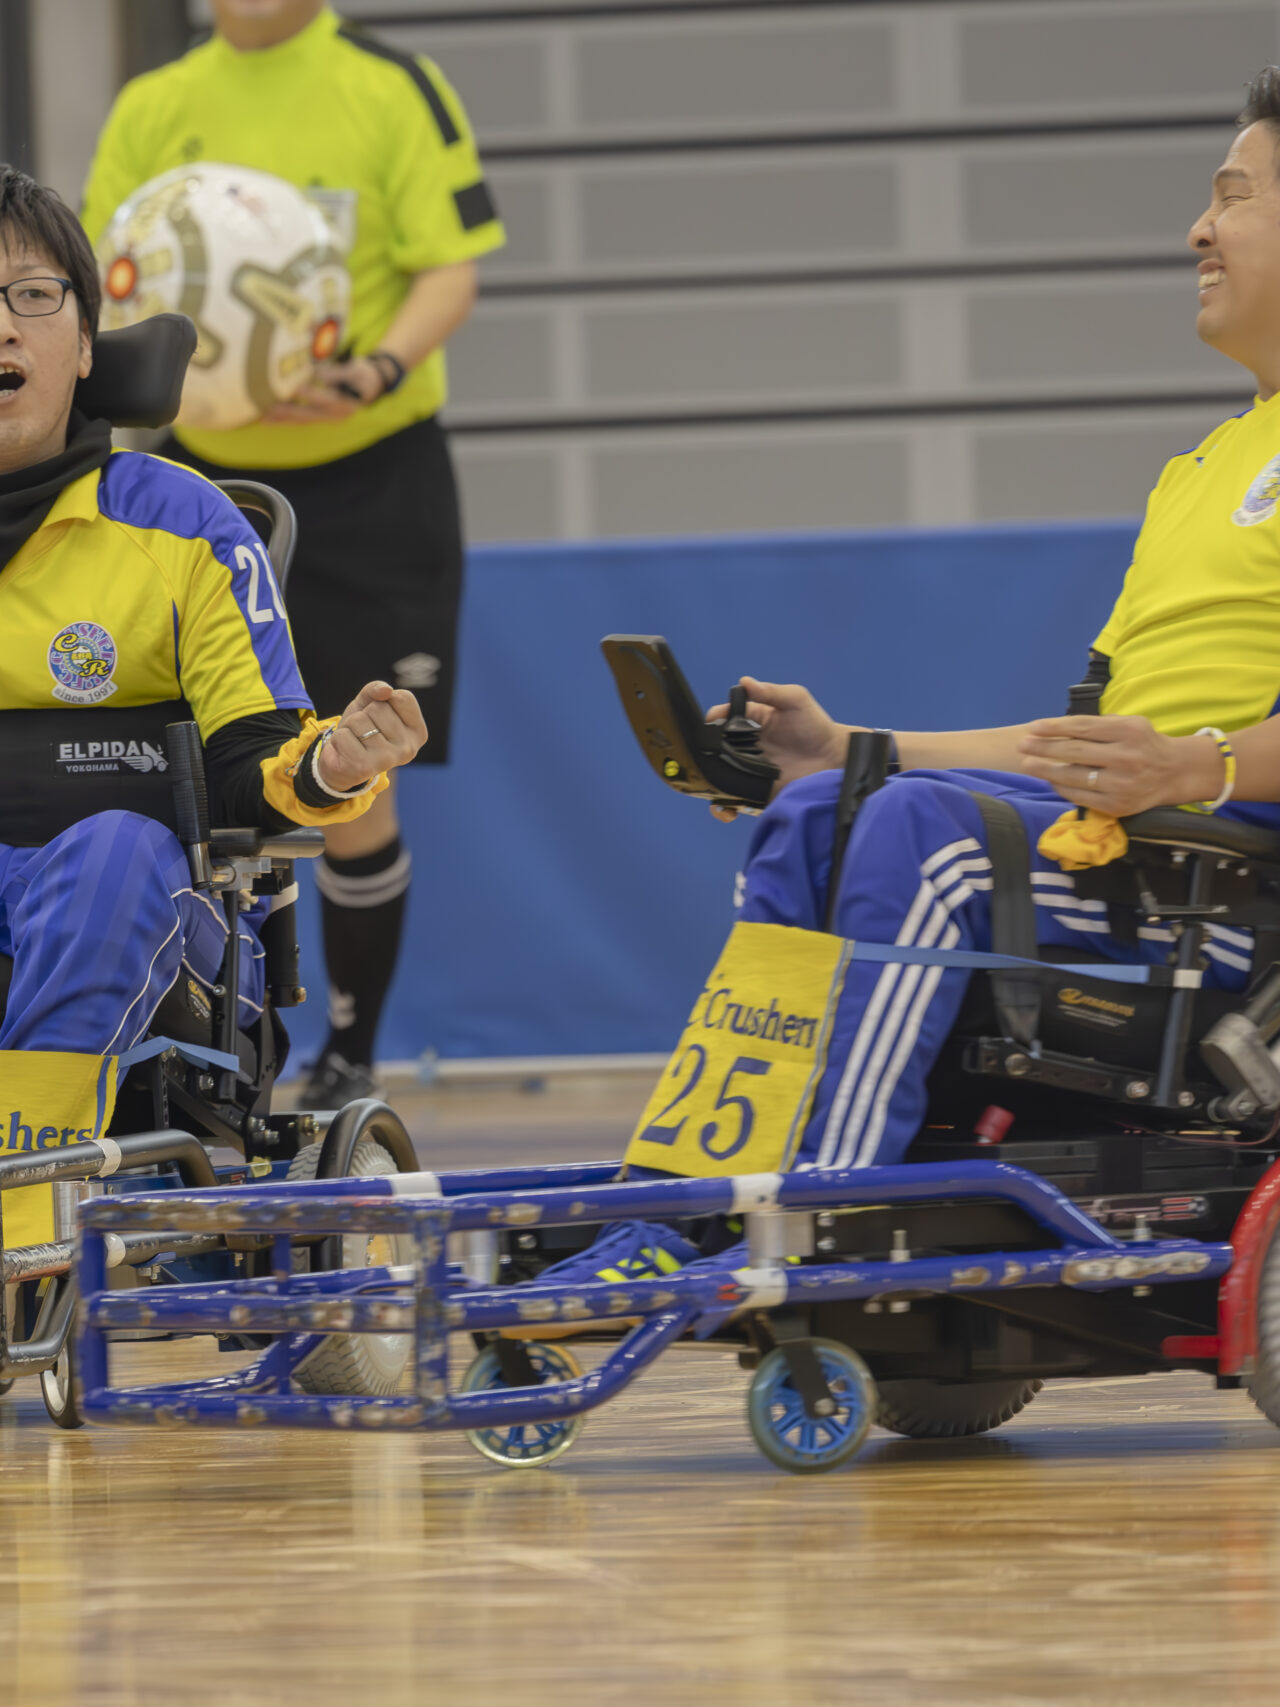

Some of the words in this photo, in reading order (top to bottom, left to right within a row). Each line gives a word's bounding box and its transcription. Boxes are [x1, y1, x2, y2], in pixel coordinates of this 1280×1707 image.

[53, 687, 85, 703] since
[88, 682, 114, 702] 1997
[60, 740, 141, 760] ELPIDA
[66, 763, 120, 773] YOKOHAMA
[638, 1043, 773, 1161] 25
